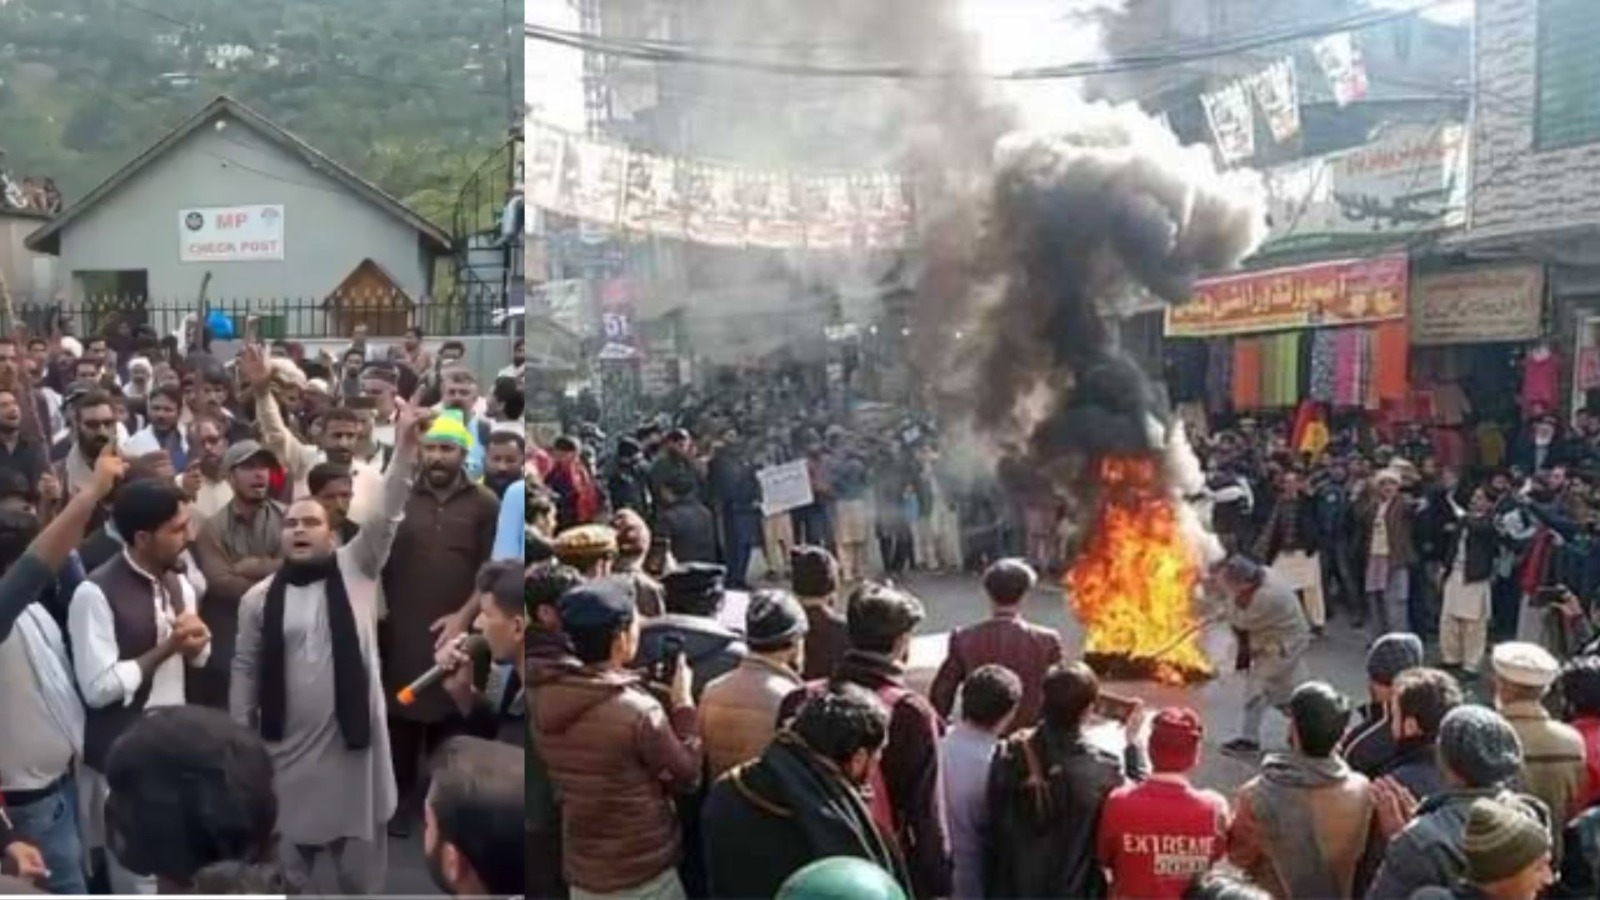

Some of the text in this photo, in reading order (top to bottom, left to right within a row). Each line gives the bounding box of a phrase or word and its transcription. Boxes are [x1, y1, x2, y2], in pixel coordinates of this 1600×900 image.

[216, 211, 248, 230] MP
[188, 239, 278, 255] CHECK POST
[1123, 832, 1216, 855] EXTREME
